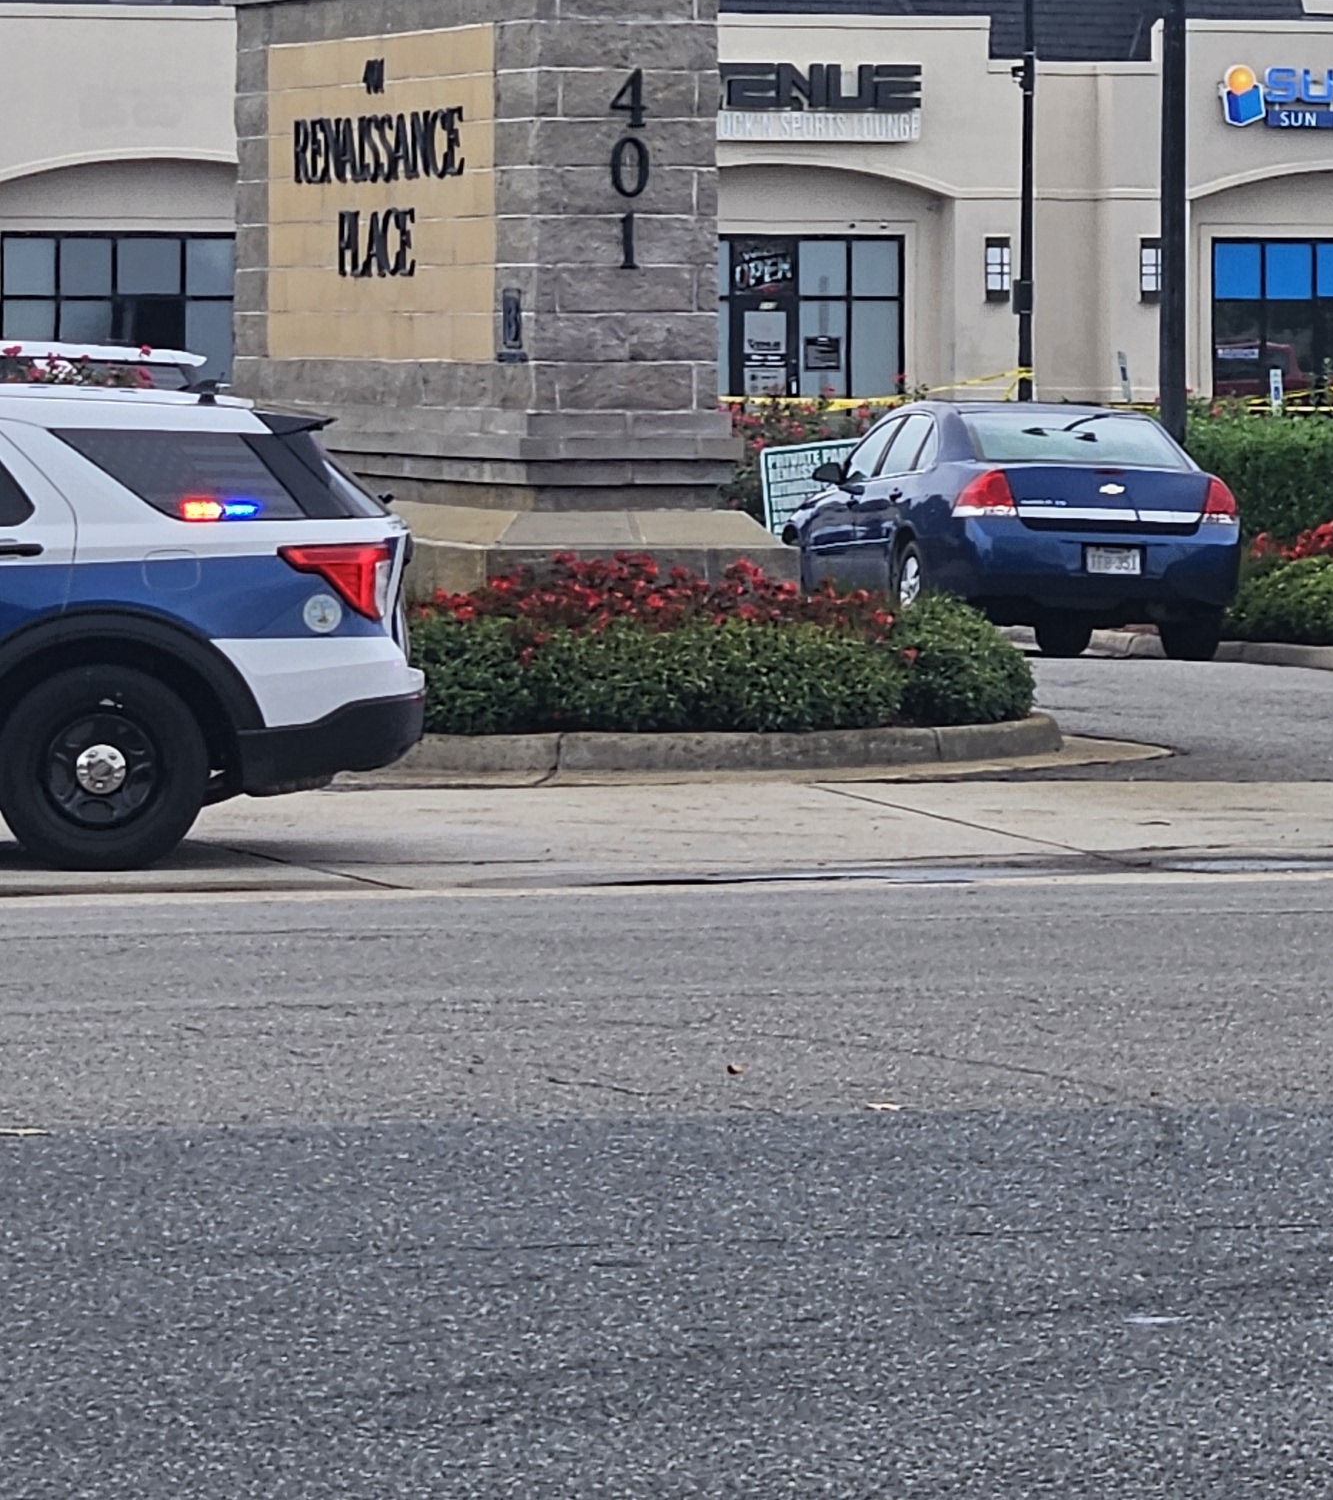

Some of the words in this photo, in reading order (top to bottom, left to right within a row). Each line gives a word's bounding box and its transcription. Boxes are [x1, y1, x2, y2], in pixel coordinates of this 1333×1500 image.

[718, 63, 921, 112] ENUE
[719, 113, 772, 138] OCK'N
[782, 114, 845, 139] SPORTS
[855, 114, 920, 140] LOUNGE
[1279, 112, 1317, 126] SUN
[294, 106, 464, 184] RENAISSANCE
[610, 68, 649, 269] 401
[338, 207, 415, 277] PLACE
[735, 257, 793, 289] OPEN
